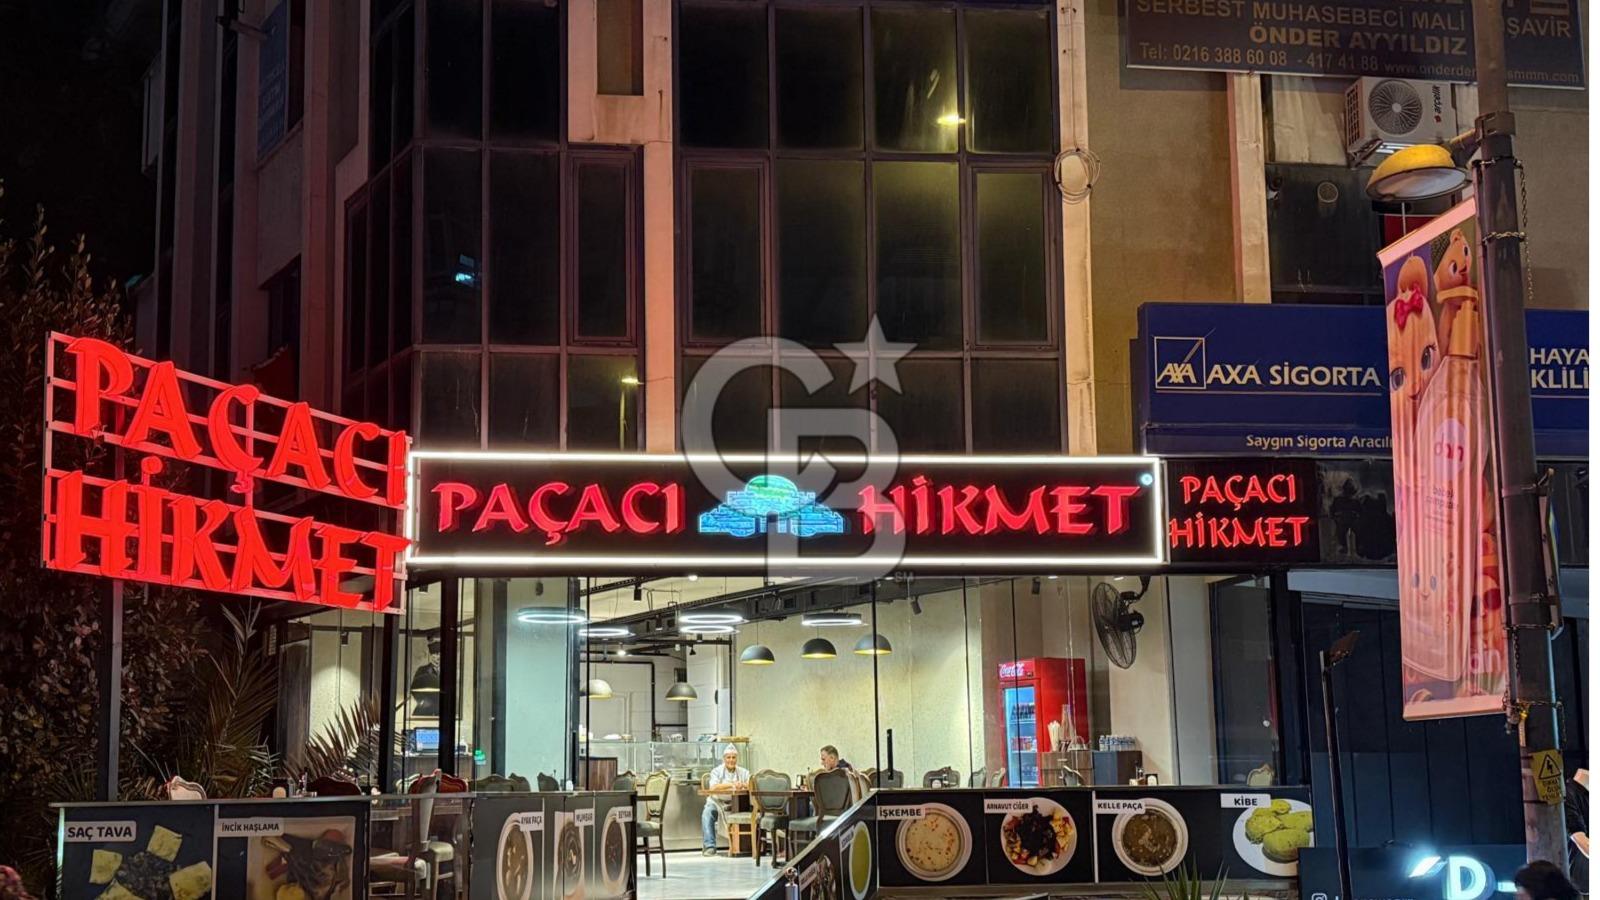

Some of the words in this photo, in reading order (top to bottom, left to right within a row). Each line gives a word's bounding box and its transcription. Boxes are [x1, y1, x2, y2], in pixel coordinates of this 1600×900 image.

[1137, 0, 1245, 17] SERBEST
[1253, 2, 1404, 28] MUHASEBECİ
[1412, 10, 1465, 31] MALİ
[1250, 22, 1341, 48] ÖNDER
[1349, 31, 1468, 55] AYYILDIZ
[1139, 42, 1168, 60] Tel:
[1173, 45, 1210, 62] 0216
[1214, 47, 1242, 63] 388
[1246, 49, 1264, 65] 60
[1269, 50, 1287, 66] 08
[1307, 52, 1332, 68] 417
[1338, 53, 1355, 70] 41
[1361, 55, 1379, 71] 88
[1206, 363, 1263, 385] AXA
[1269, 361, 1382, 387] SİGORTA
[64, 336, 405, 506] PAÇACI
[1246, 434, 1294, 450] Saygın
[1297, 435, 1347, 450] Sigorta
[1179, 474, 1297, 511] PAÇACI
[431, 482, 681, 545] PAÇACI
[857, 475, 1141, 535] HİKMET
[54, 456, 411, 611] HİKMET
[1168, 511, 1310, 548] HİKMET
[879, 807, 922, 818] İŞKEMBE
[986, 802, 1012, 810] ARNAVUT
[1097, 802, 1121, 810] KELLE
[1122, 802, 1143, 812] PAÇA
[1234, 796, 1258, 807] KİBE
[67, 826, 93, 840] SAÇ
[96, 826, 133, 838] TAVA
[221, 822, 242, 832] İNCİK
[243, 823, 280, 833] HAŞLAMA
